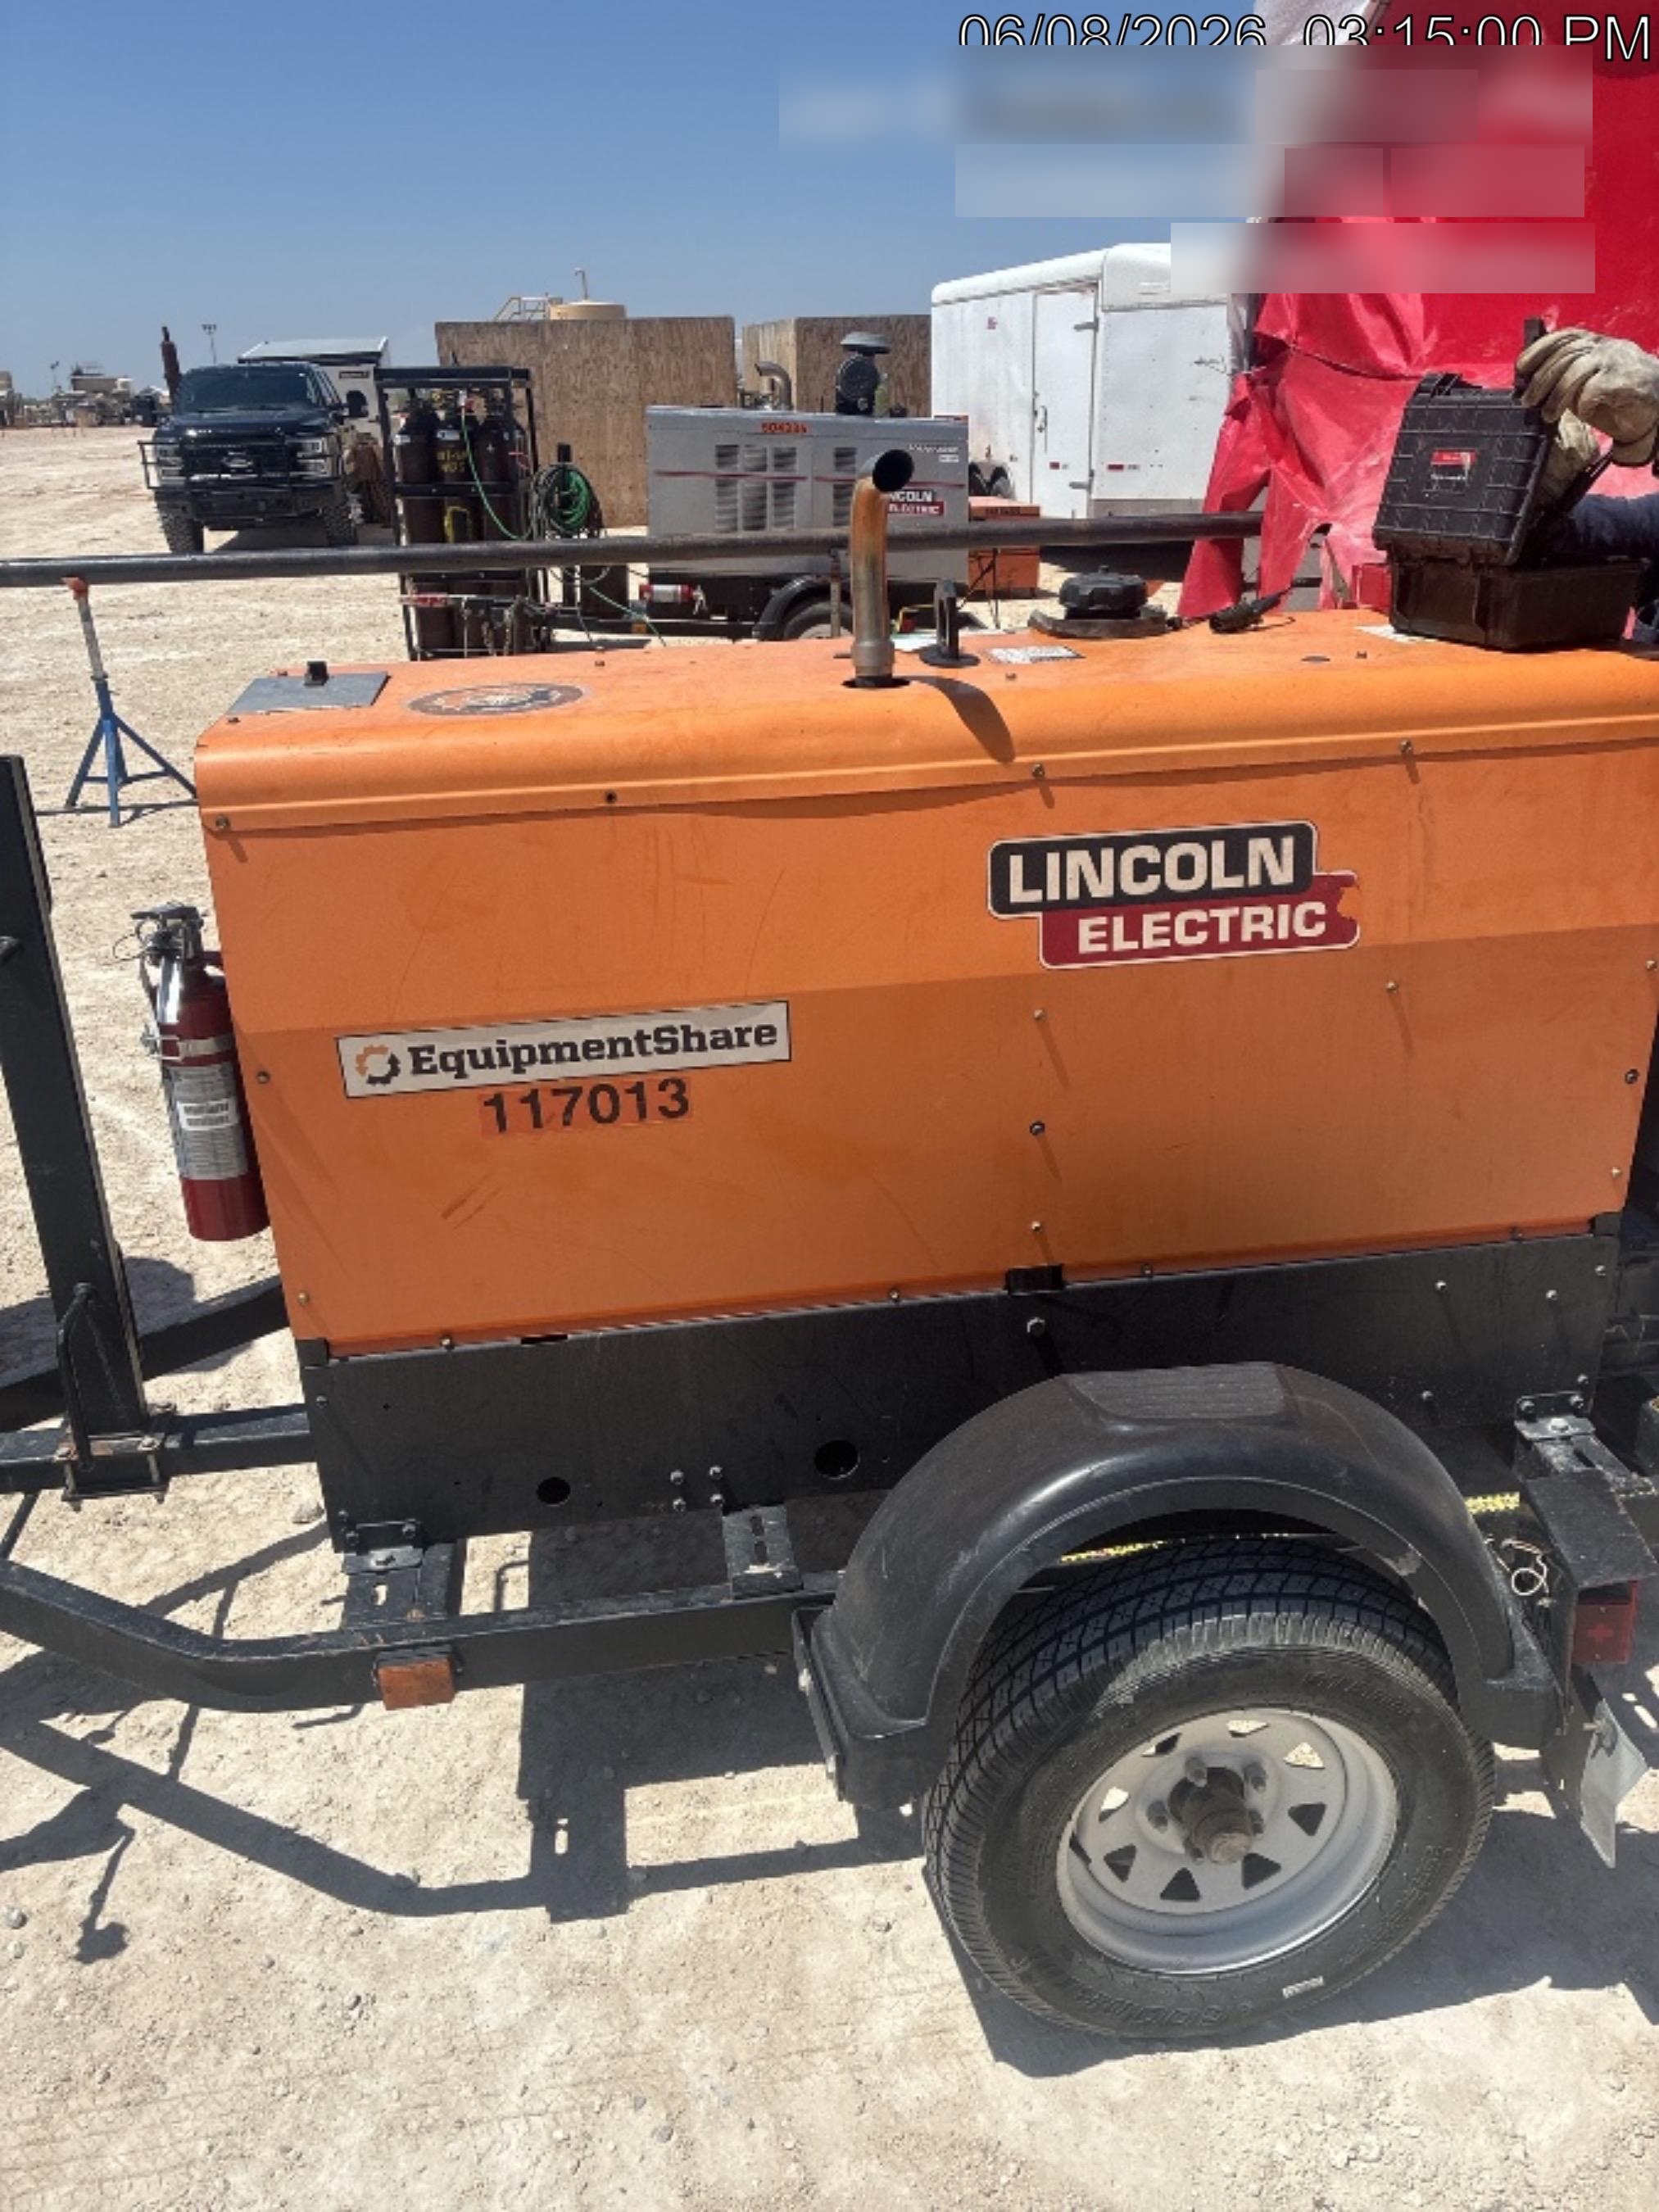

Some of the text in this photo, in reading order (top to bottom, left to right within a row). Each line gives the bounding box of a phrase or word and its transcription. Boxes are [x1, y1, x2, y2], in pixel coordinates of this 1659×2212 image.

[1009, 835, 1295, 904] LINCOLN
[1077, 901, 1328, 954] ELECTRIC
[408, 1023, 777, 1080] EquipmentShare
[483, 1077, 690, 1133] 117013
